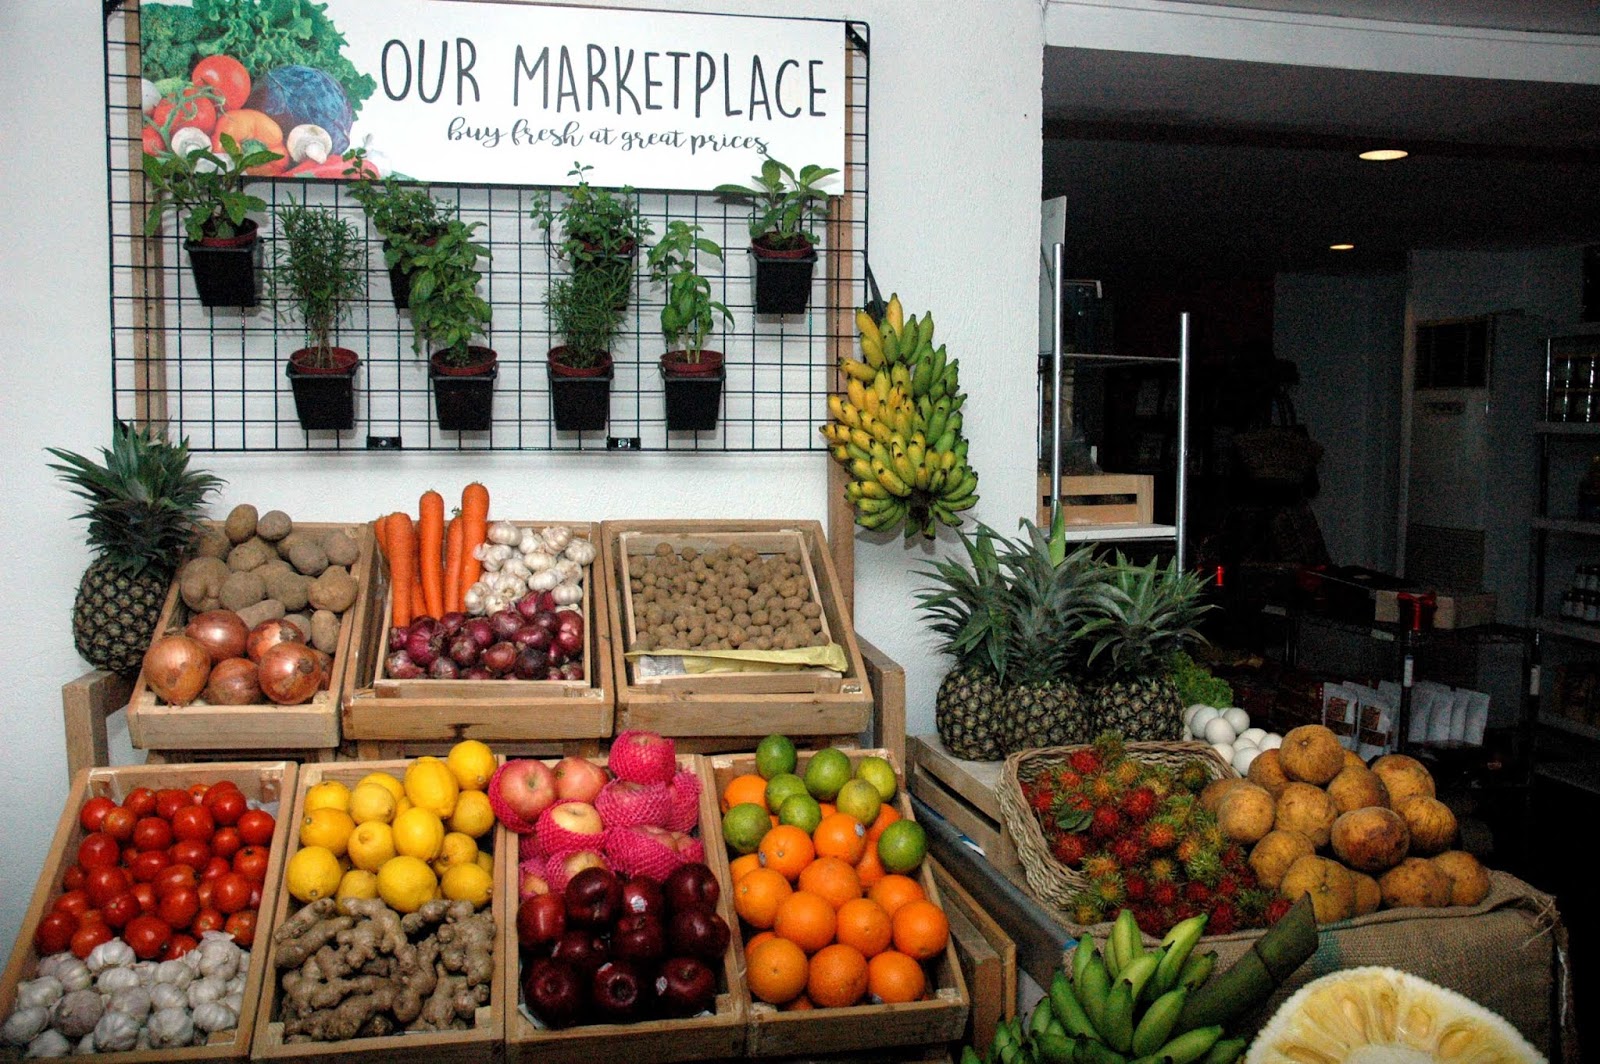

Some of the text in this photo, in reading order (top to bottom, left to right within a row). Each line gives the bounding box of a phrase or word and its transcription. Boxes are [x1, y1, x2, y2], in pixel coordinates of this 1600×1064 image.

[382, 38, 827, 121] OUR MARKETPLACE
[448, 117, 768, 155] buy fresh at great prices
